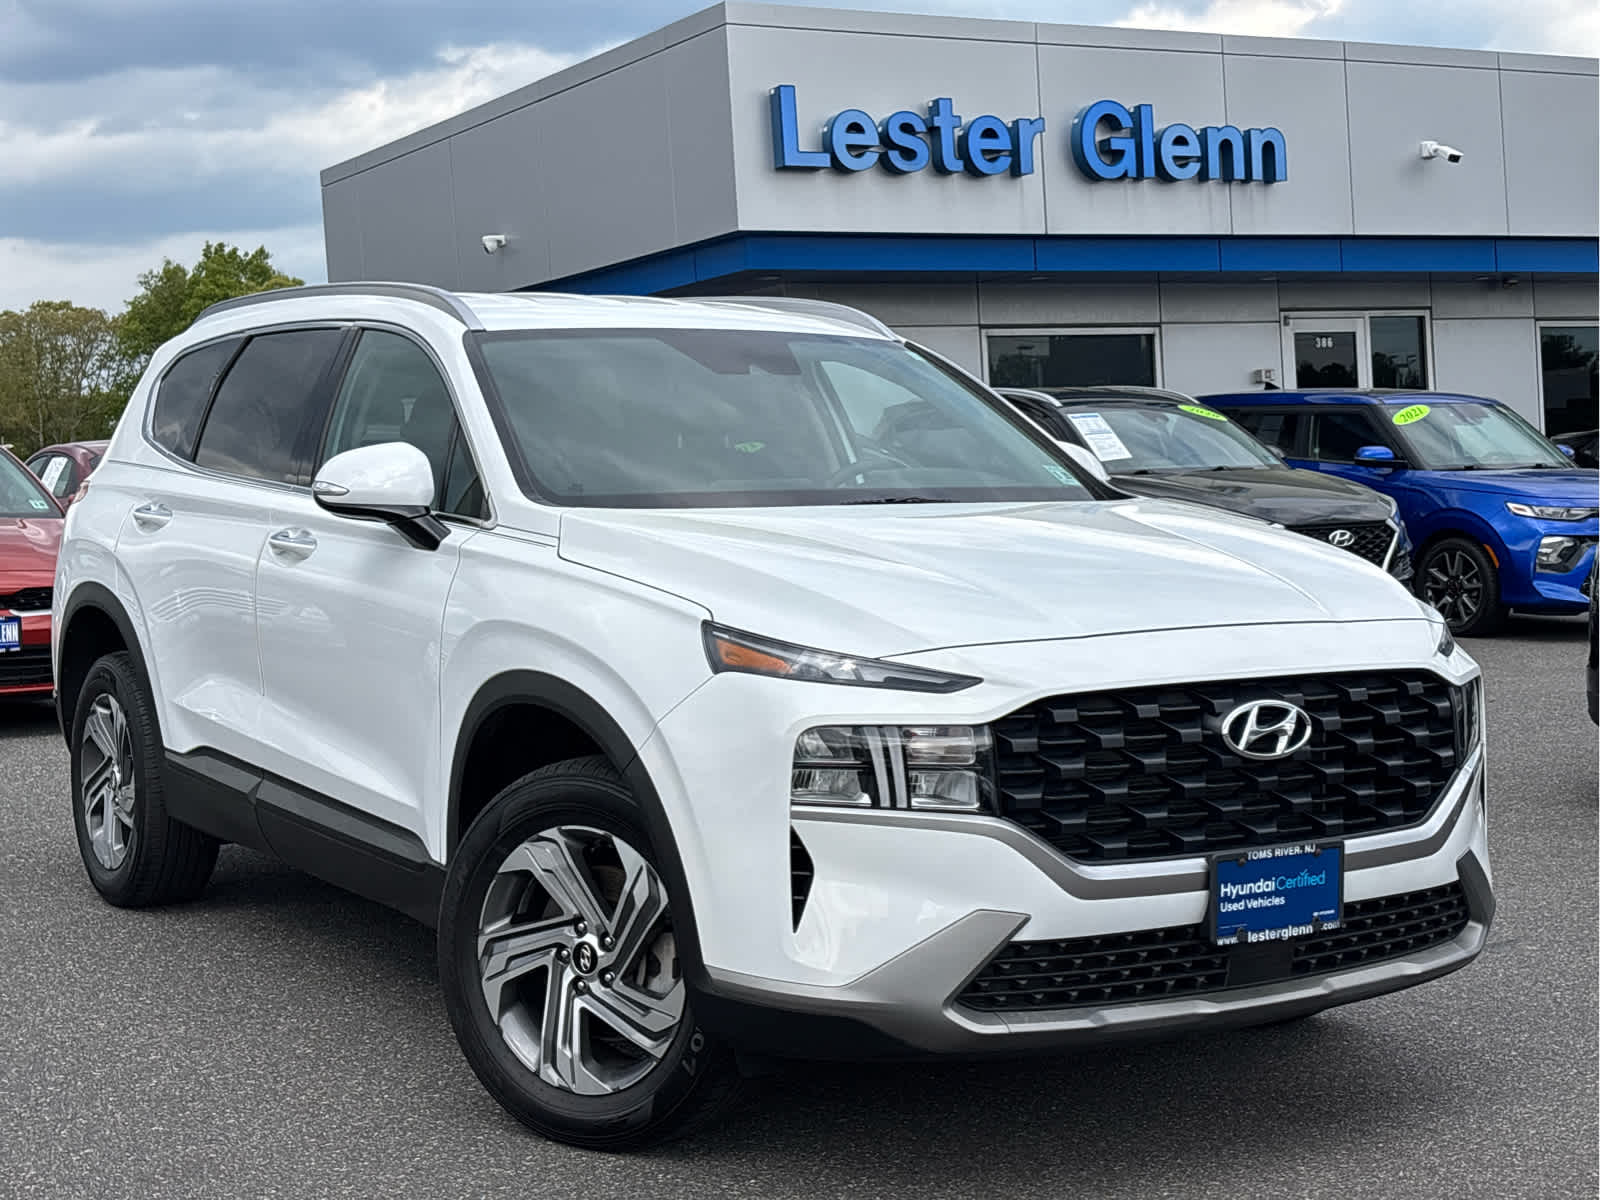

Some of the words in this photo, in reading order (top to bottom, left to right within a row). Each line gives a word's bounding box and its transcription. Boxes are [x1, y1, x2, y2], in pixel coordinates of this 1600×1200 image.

[769, 84, 1045, 177] Lester
[1071, 99, 1288, 184] Glenn
[1399, 407, 1425, 423] 2021
[0, 622, 19, 643] ENN
[1219, 899, 1245, 912] Used
[1246, 896, 1285, 910] Vehicles
[1247, 924, 1313, 943] lesterglenn
